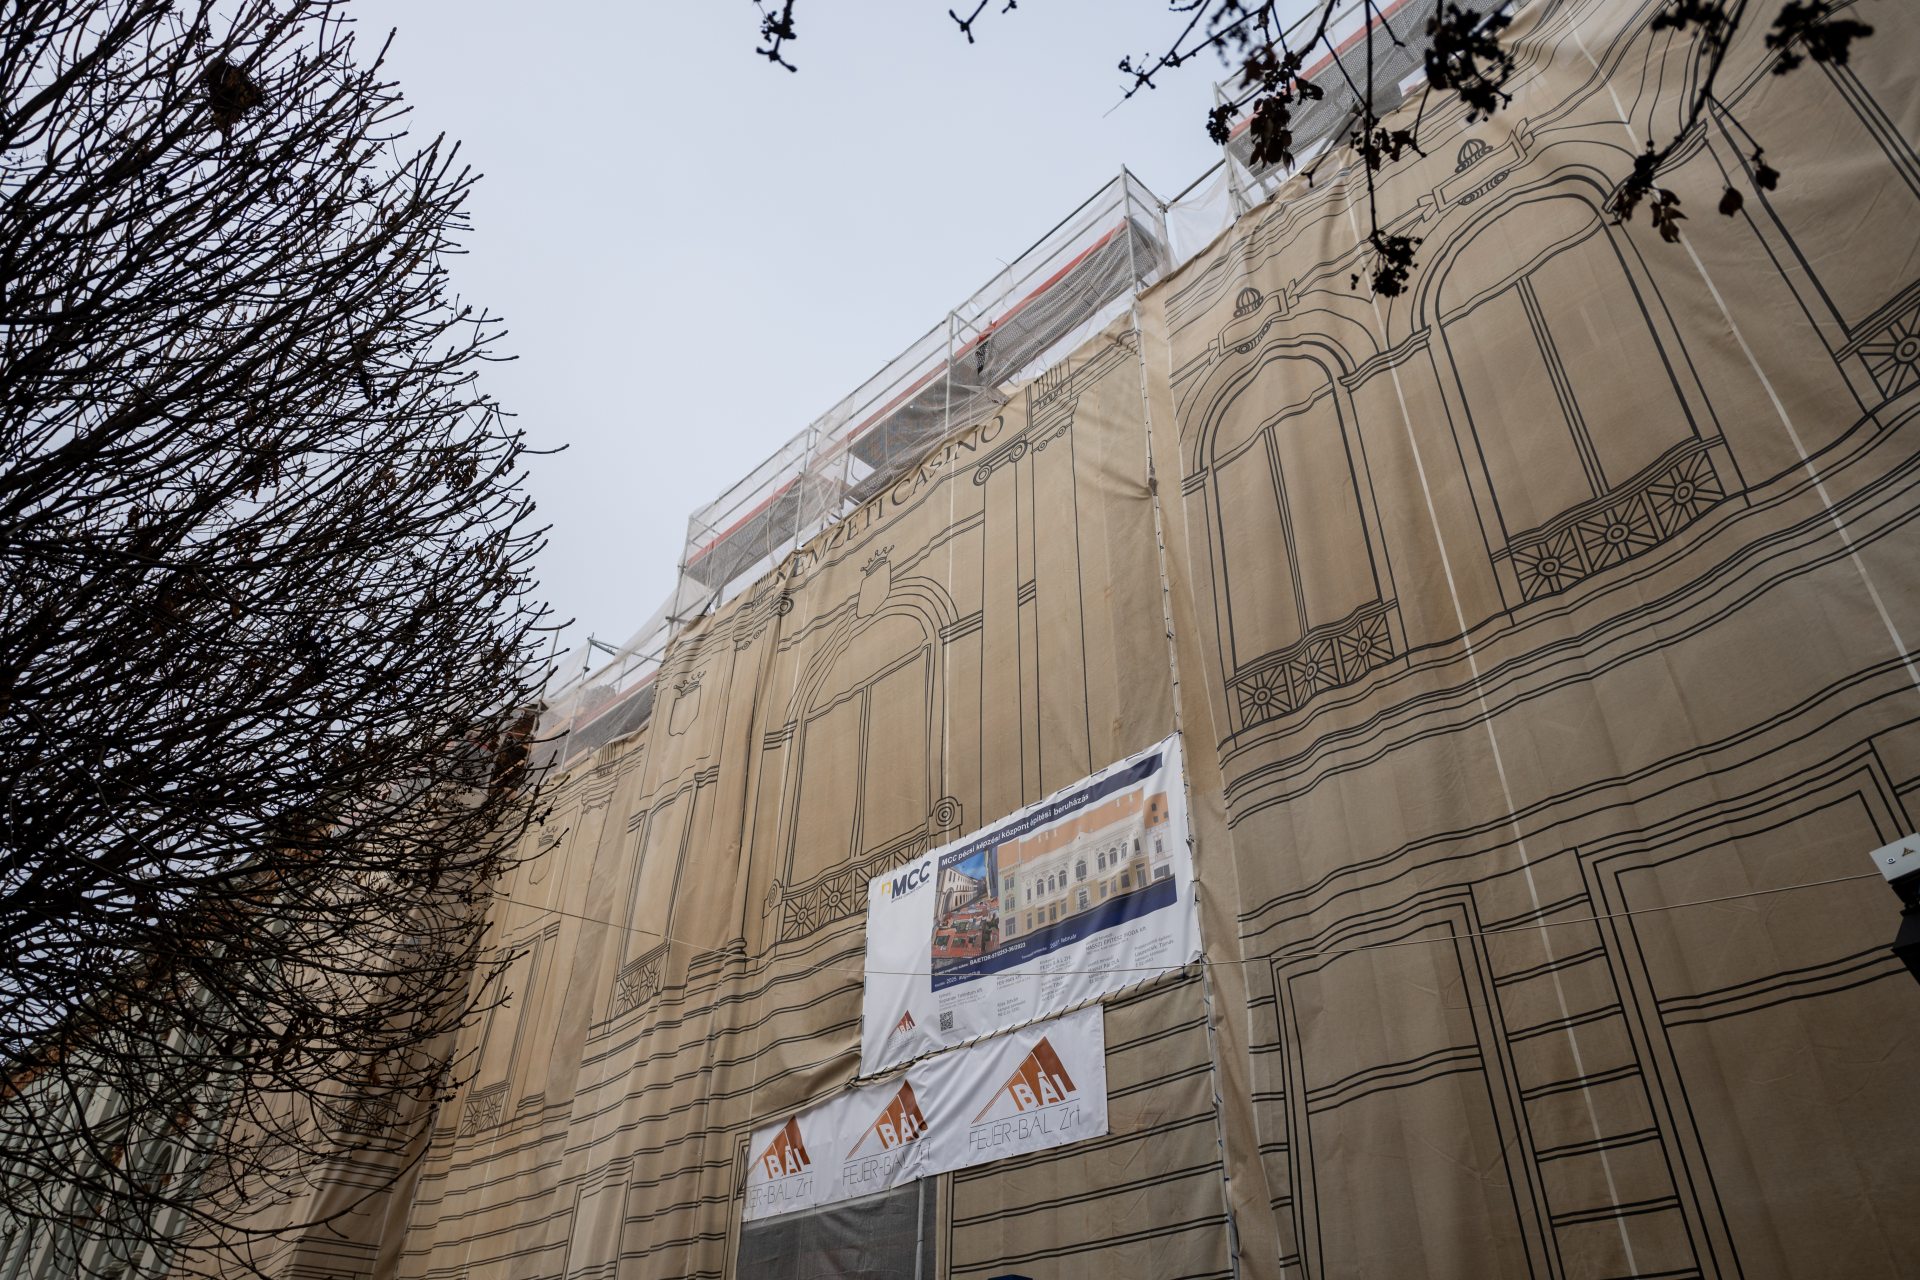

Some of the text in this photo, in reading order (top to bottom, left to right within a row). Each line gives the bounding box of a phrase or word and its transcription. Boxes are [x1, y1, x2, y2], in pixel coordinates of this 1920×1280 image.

[891, 415, 1004, 506] CASINO
[892, 860, 931, 899] MCC
[942, 855, 957, 866] MCC
[1012, 1071, 1068, 1109] BÁL
[878, 1112, 923, 1146] BÁL
[969, 1111, 1053, 1152] FEJÉR-BÁL
[766, 1144, 807, 1177] BÁL
